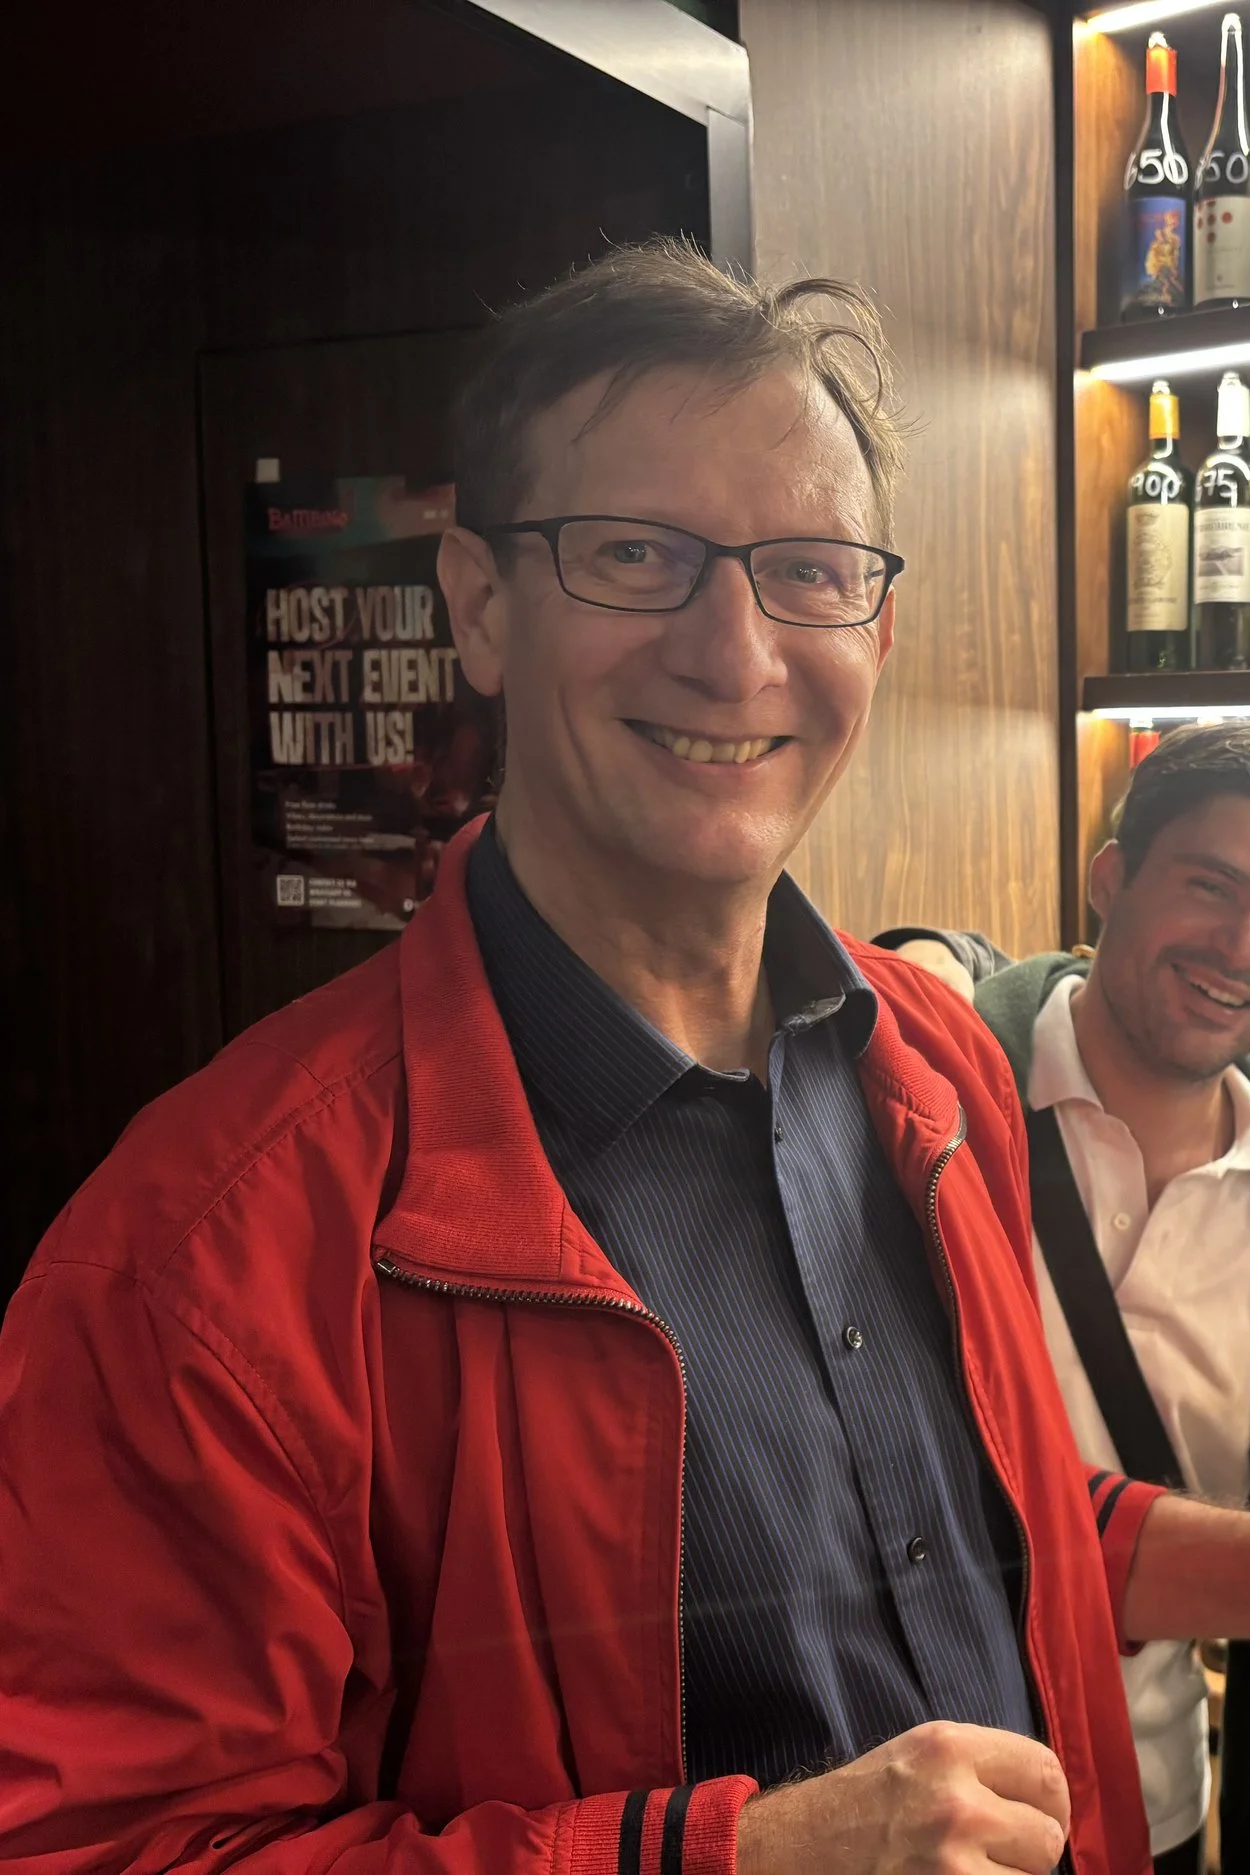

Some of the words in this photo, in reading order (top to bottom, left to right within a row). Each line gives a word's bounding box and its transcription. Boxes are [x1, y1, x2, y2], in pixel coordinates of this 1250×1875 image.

[267, 587, 349, 643] HOST
[355, 586, 435, 641] YOUR
[268, 650, 352, 703] NEXT
[363, 649, 458, 703] EVENT
[269, 711, 355, 765] WITH
[366, 710, 415, 766] US!
